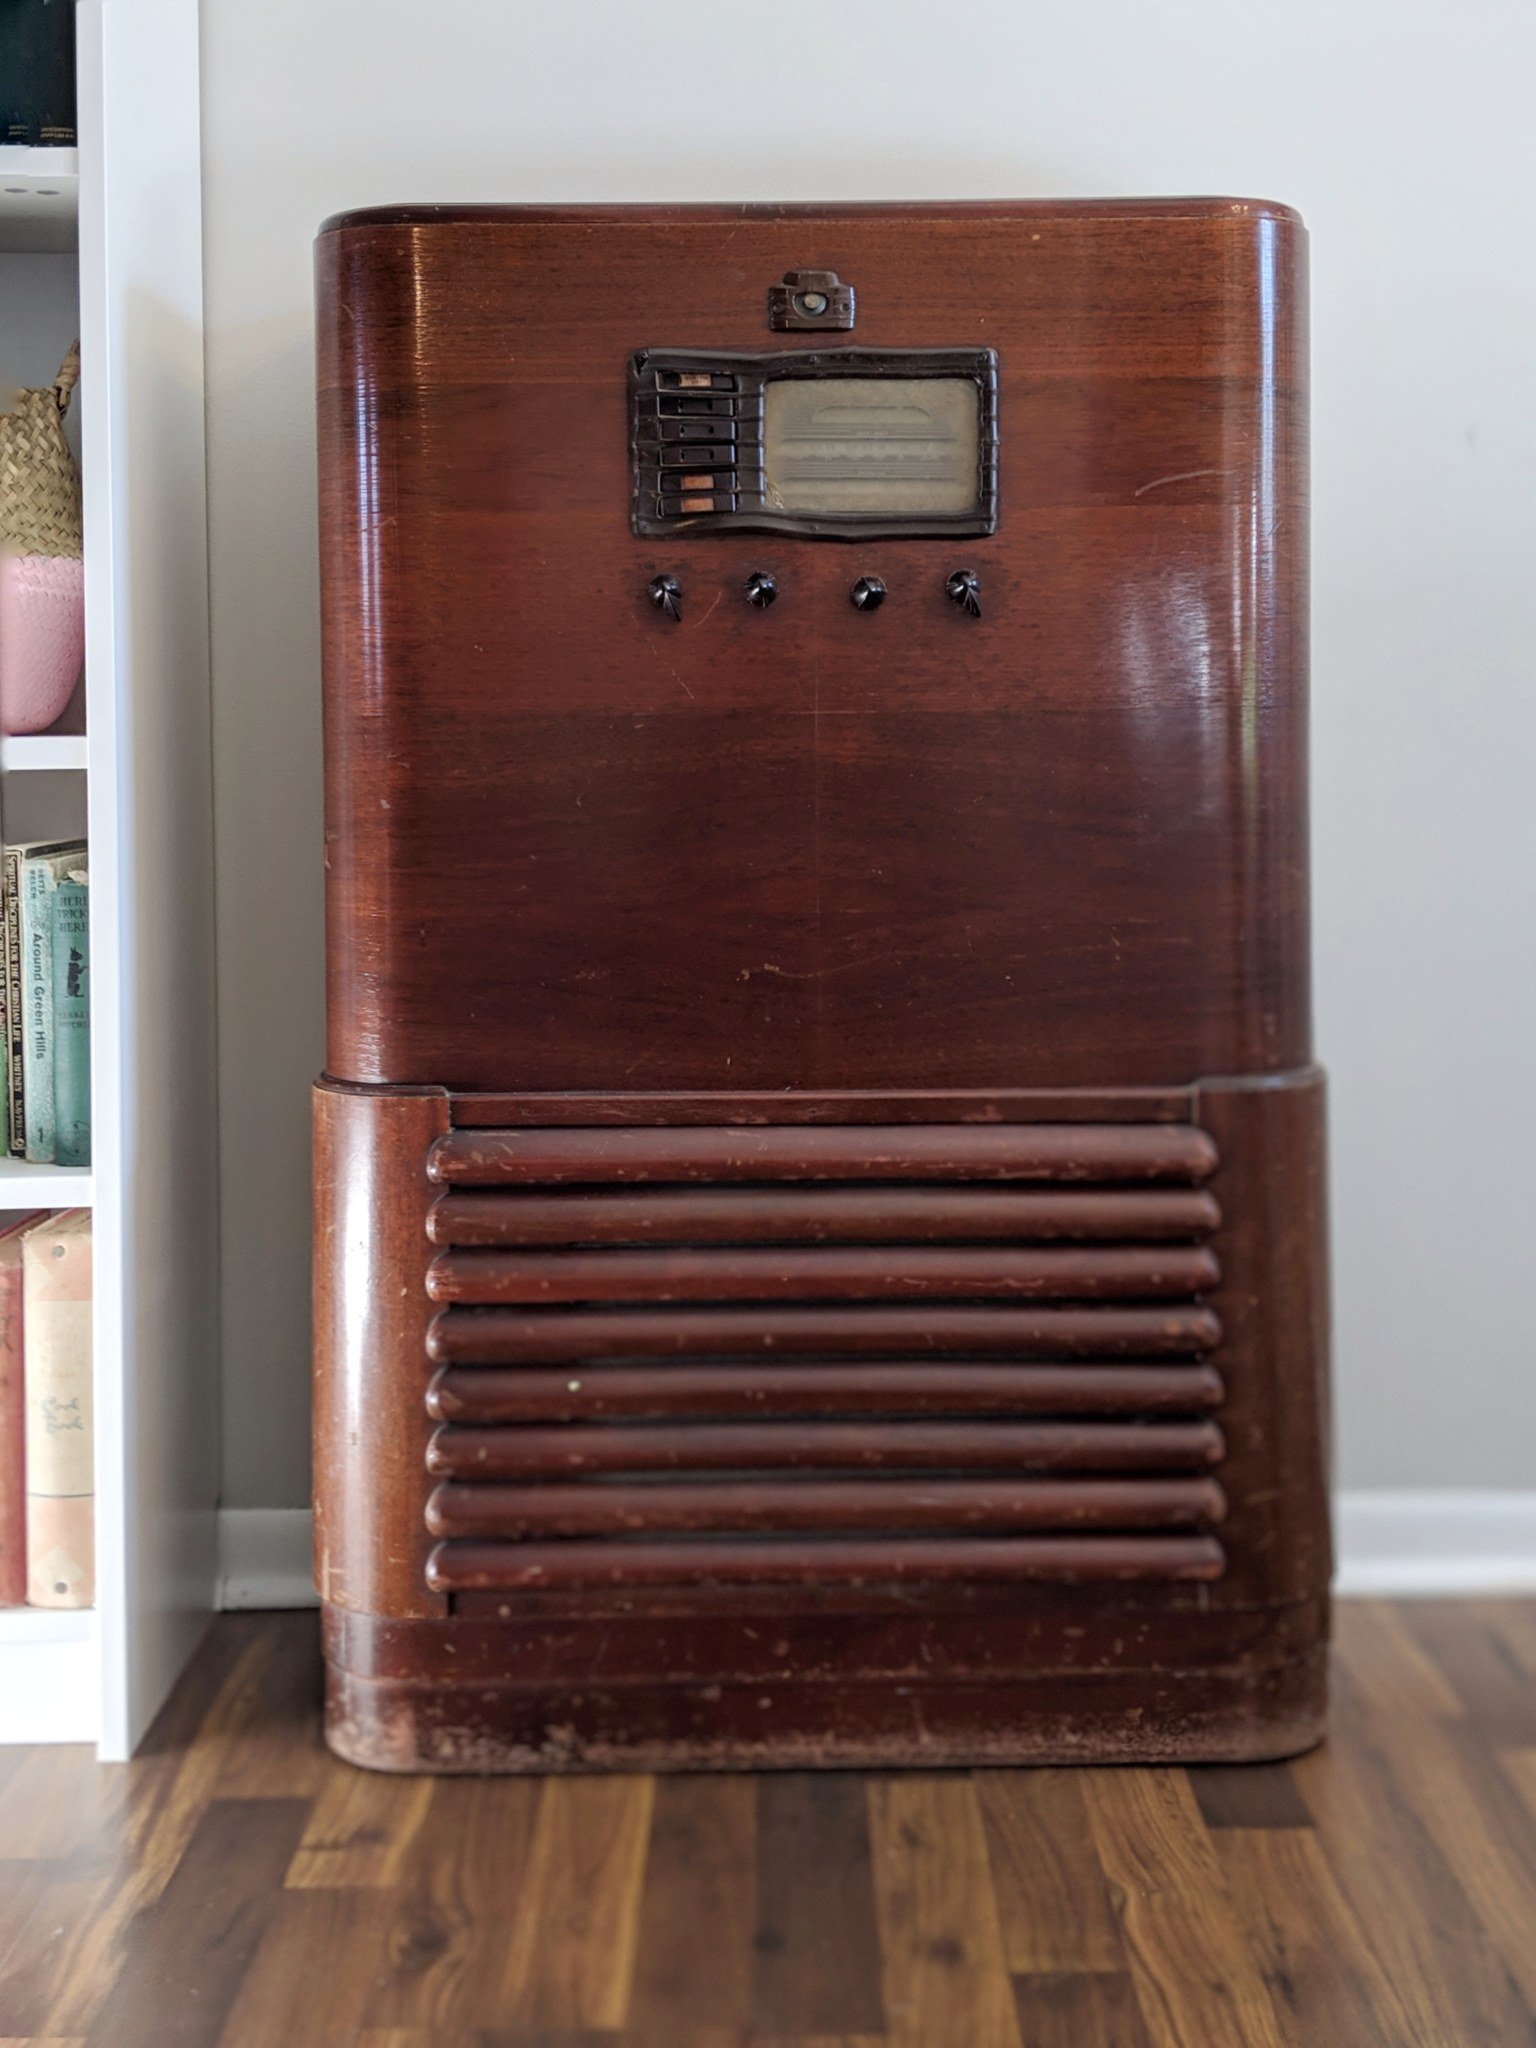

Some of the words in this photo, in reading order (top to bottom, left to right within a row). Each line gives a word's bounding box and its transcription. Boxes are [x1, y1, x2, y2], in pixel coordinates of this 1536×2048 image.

[9, 896, 19, 944] DISCIPLINES
[10, 945, 19, 961] FOR
[11, 963, 20, 979] THE
[33, 933, 45, 981] Around
[11, 980, 21, 1023] CHRISTIAN
[34, 986, 45, 1026] Green
[12, 1024, 22, 1043] LIFE
[35, 1031, 46, 1060] Hills
[13, 1054, 22, 1093] WHITNEY
